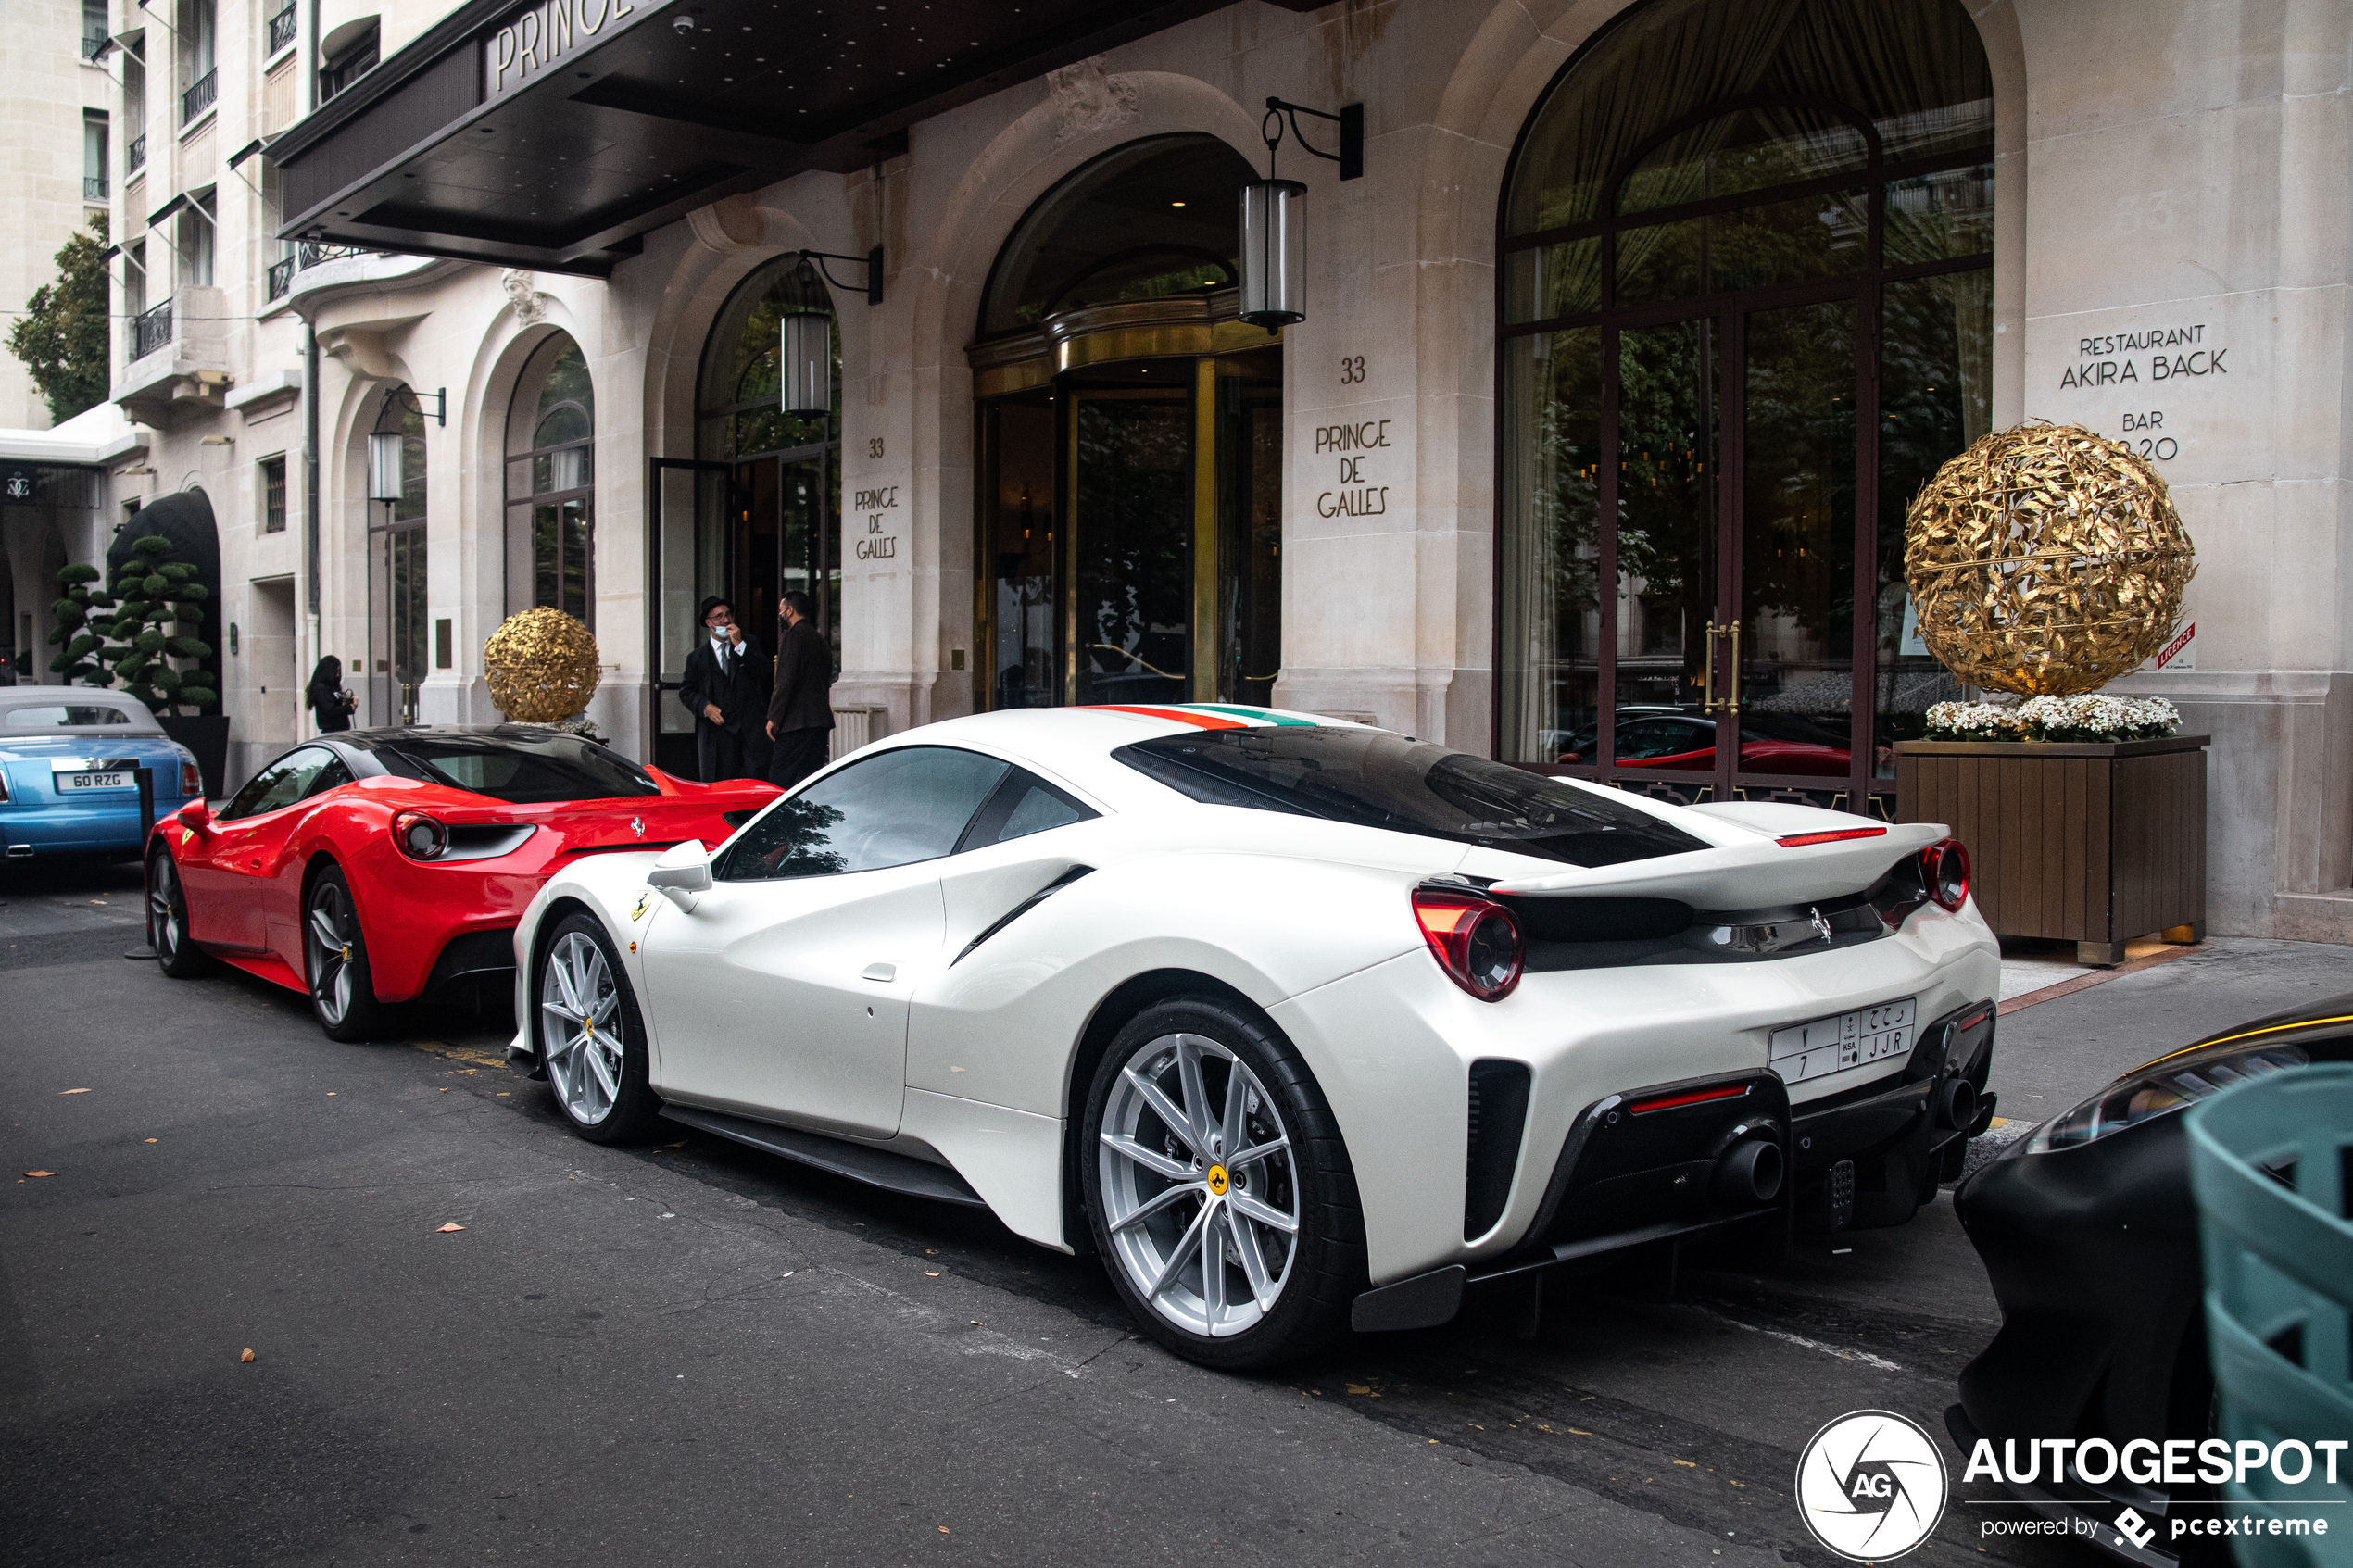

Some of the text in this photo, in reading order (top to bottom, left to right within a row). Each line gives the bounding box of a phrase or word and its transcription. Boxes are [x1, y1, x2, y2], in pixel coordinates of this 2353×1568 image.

[2080, 324, 2206, 357] RESTAURANT
[1341, 356, 1365, 384] 33
[2059, 348, 2227, 390] AKIRA BACK
[2122, 410, 2163, 432] BAR
[869, 437, 884, 458] 33
[1315, 419, 1391, 454] PRINCE
[1340, 456, 1365, 484] DE
[855, 486, 899, 511] PRINCE
[1317, 486, 1389, 518] GALLES
[869, 513, 883, 534] DE
[856, 536, 897, 560] GALLES
[2160, 627, 2192, 665] LICENCE
[73, 774, 120, 787] 60 RZG
[1843, 1041, 1856, 1052] KSA
[1869, 1031, 1902, 1058] JJR
[1799, 1055, 1807, 1077] 7
